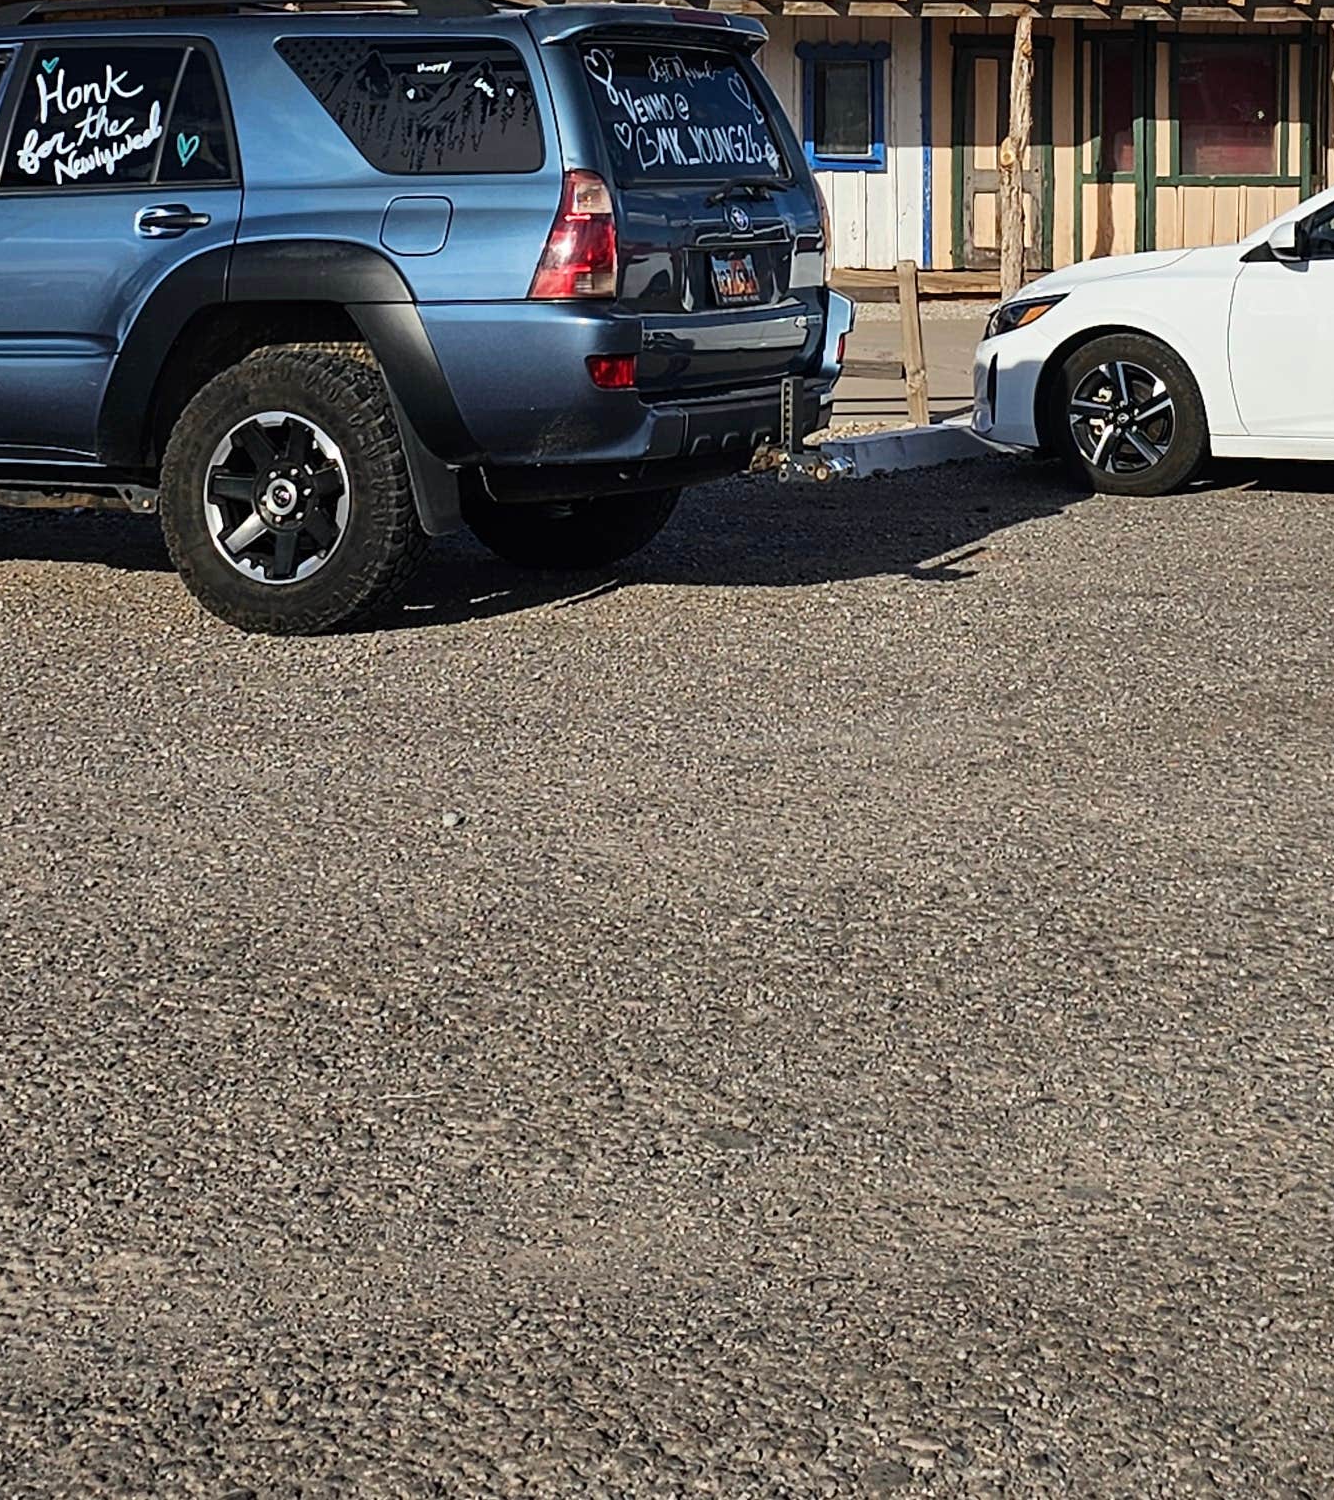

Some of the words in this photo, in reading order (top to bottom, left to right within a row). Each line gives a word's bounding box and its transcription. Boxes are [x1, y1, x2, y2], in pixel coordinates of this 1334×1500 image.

[36, 64, 144, 124] Honk
[16, 129, 75, 175] for
[75, 105, 135, 146] the
